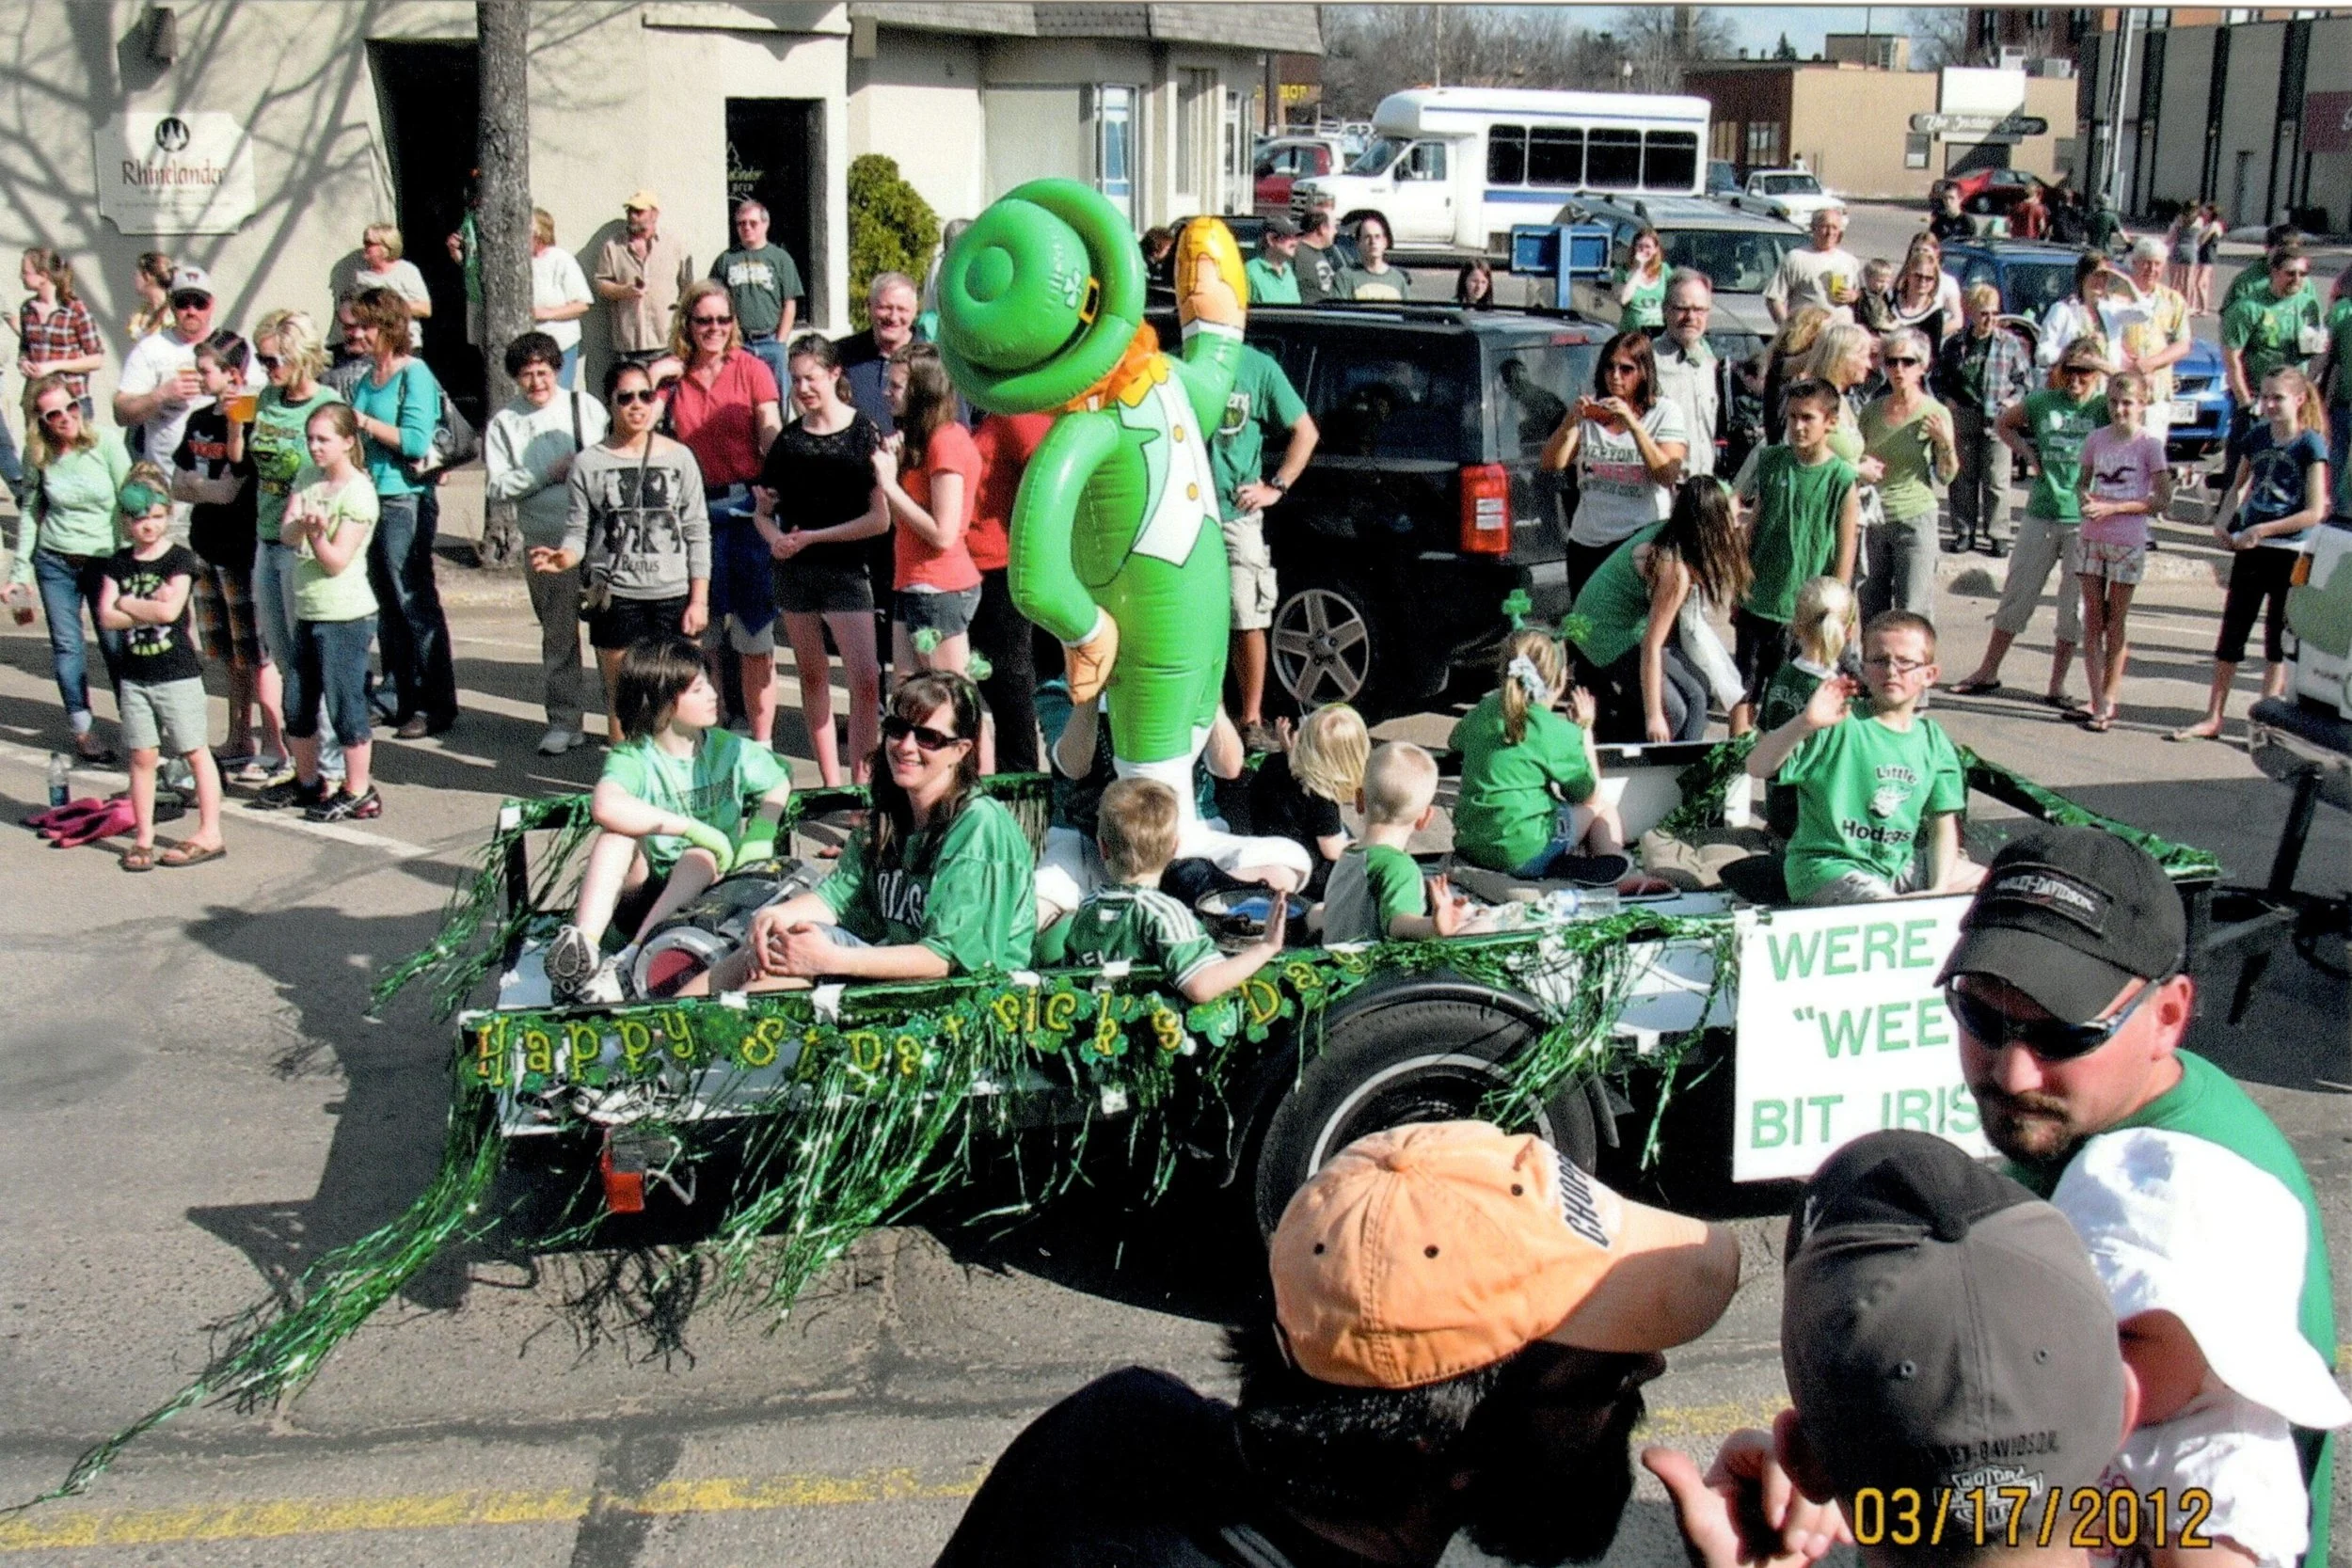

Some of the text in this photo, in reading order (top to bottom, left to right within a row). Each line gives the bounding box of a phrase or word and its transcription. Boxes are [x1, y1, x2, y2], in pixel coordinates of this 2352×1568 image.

[121, 158, 226, 185] Rhinelander
[1876, 767, 1916, 784] Little
[1767, 919, 1938, 981] WERE
[477, 1010, 694, 1087] Happy
[1238, 949, 1366, 1024] Day
[1751, 1083, 1982, 1149] BIT IRIS
